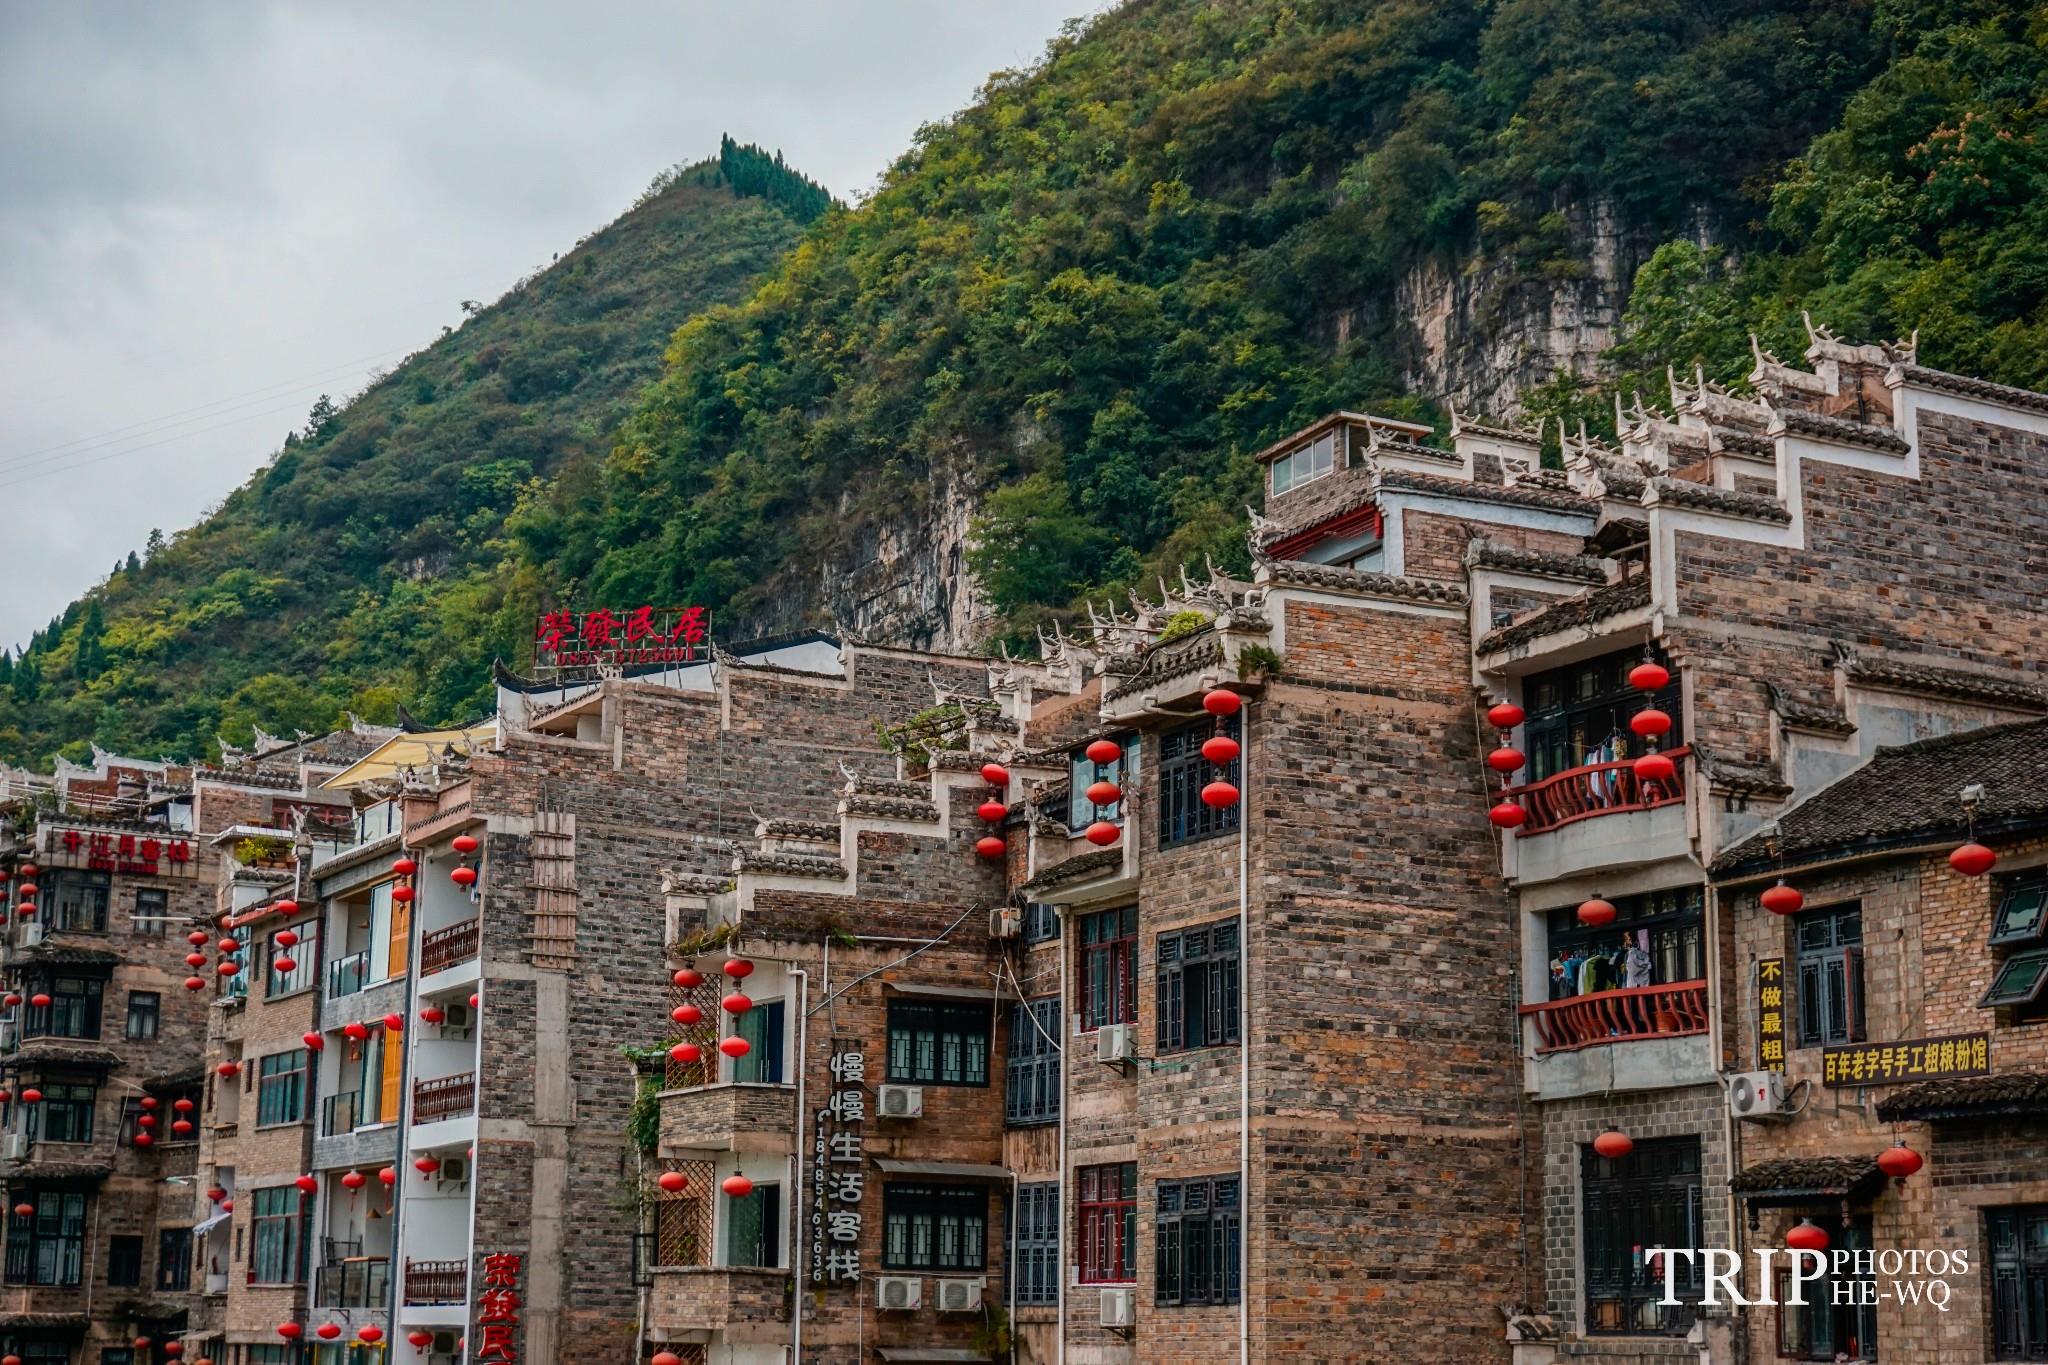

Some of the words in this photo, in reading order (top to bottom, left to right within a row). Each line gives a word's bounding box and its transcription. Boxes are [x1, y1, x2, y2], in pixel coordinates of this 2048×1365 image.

[1760, 960, 1784, 1061] 不做最粗
[1823, 1037, 1988, 1082] 百年老字号手工粗粮粉馆
[812, 1127, 825, 1282] 18485463636
[826, 1051, 865, 1281] 慢慢生活客栈
